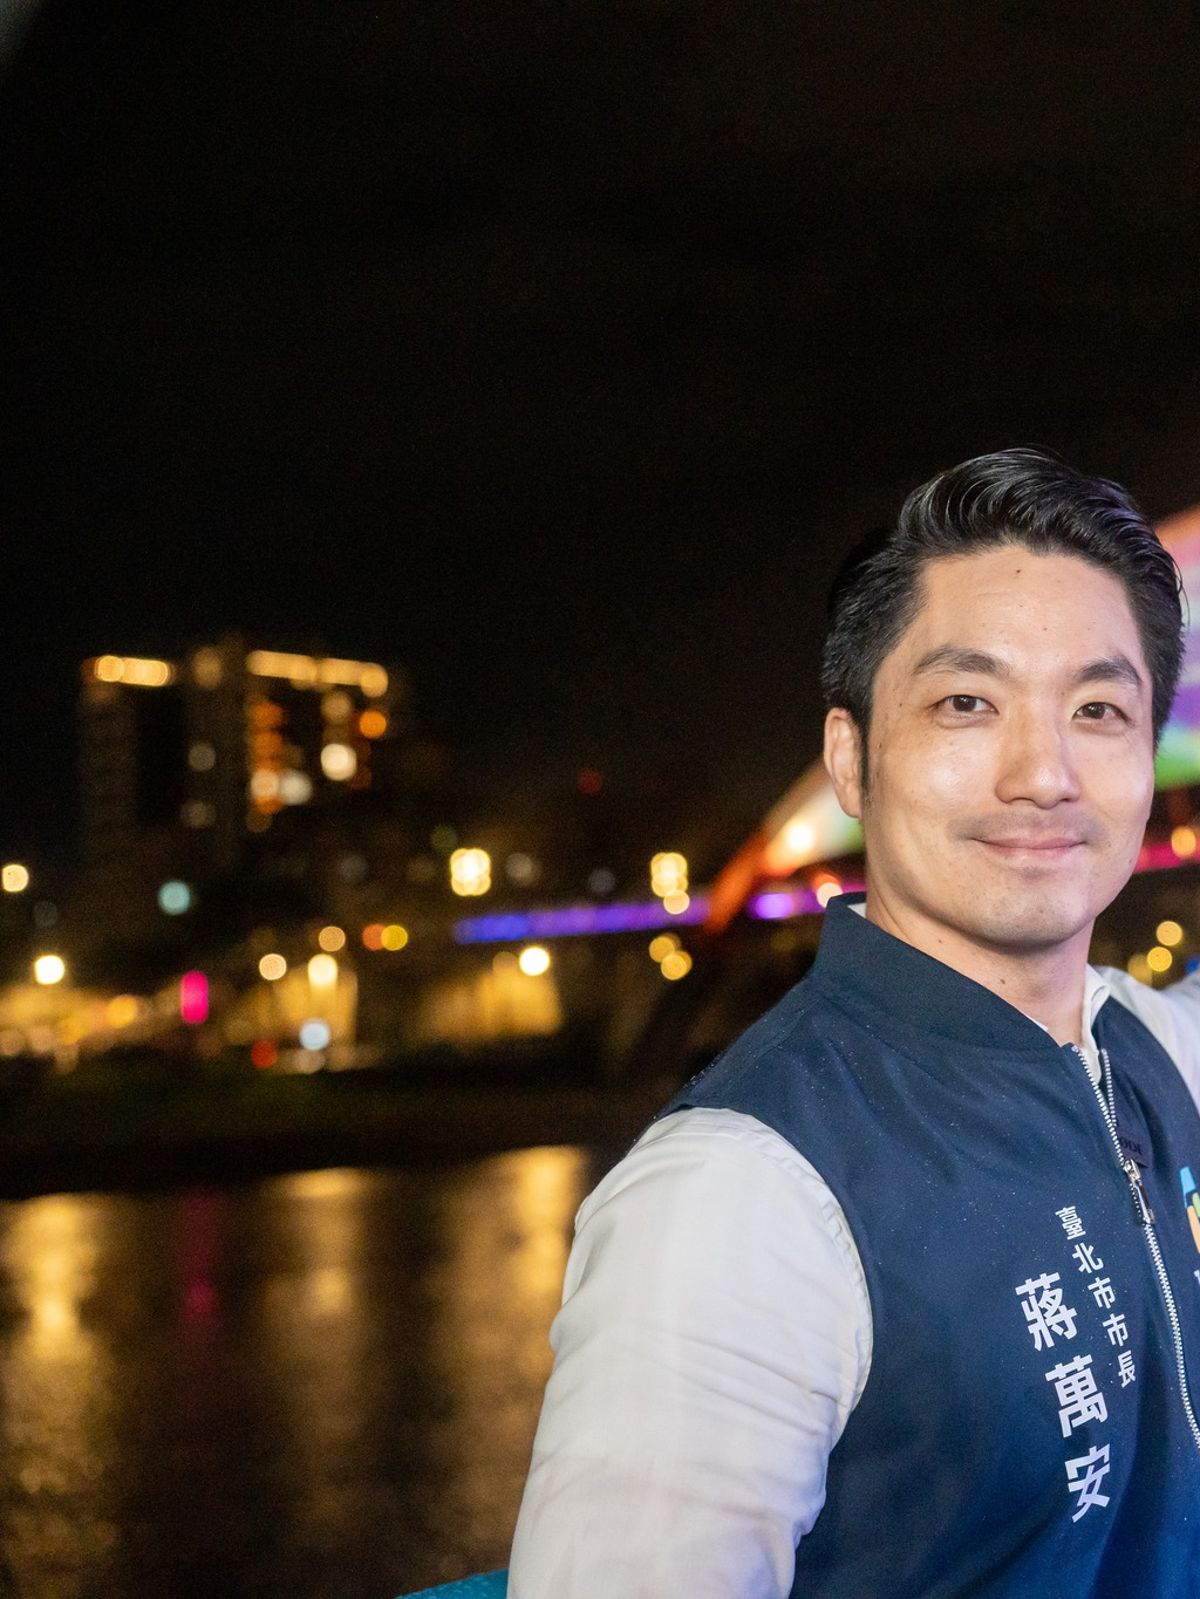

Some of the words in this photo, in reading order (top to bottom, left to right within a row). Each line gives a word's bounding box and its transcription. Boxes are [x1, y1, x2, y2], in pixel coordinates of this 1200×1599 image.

[1015, 1271, 1111, 1523] 蔣萬安
[1055, 1205, 1136, 1388] 臺北市市長
